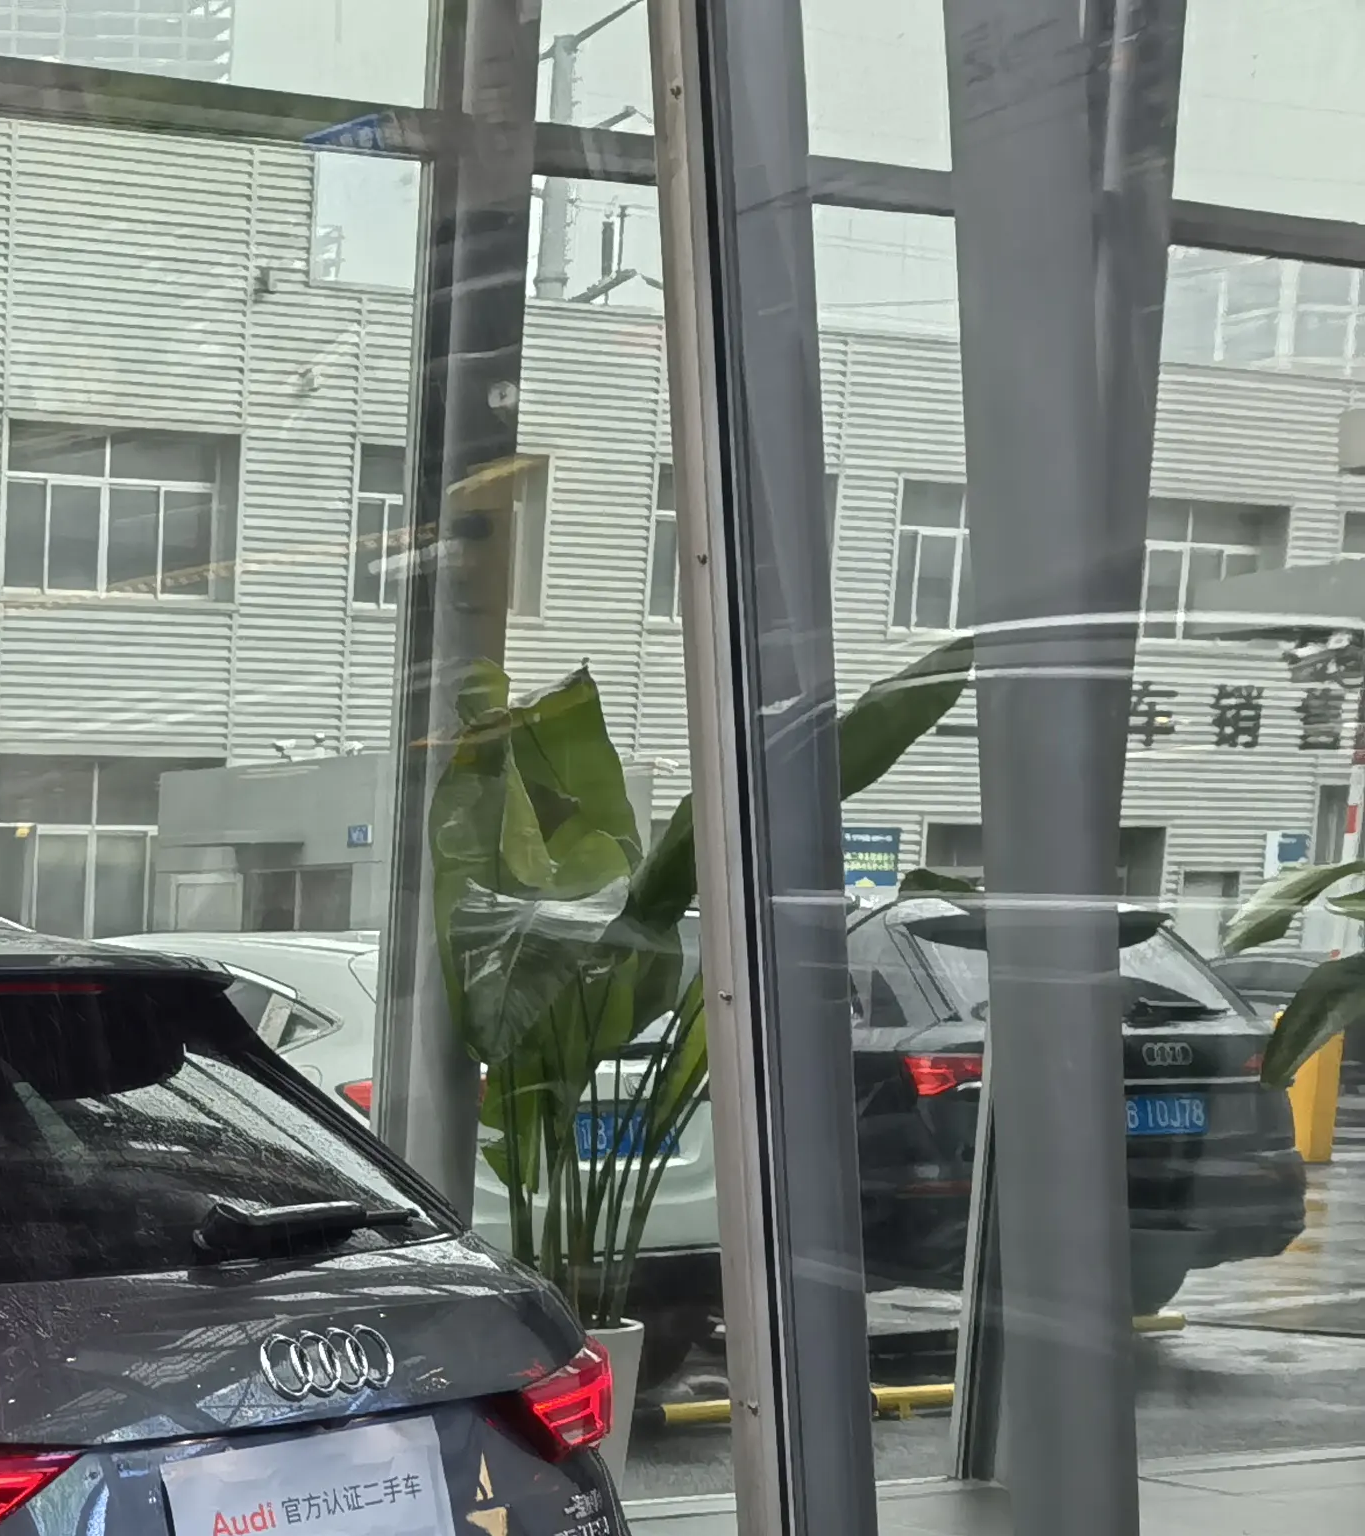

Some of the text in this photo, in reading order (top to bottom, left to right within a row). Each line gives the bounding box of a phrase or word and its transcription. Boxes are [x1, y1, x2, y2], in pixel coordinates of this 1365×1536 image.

[281, 1473, 422, 1525] 官方认证二手车
